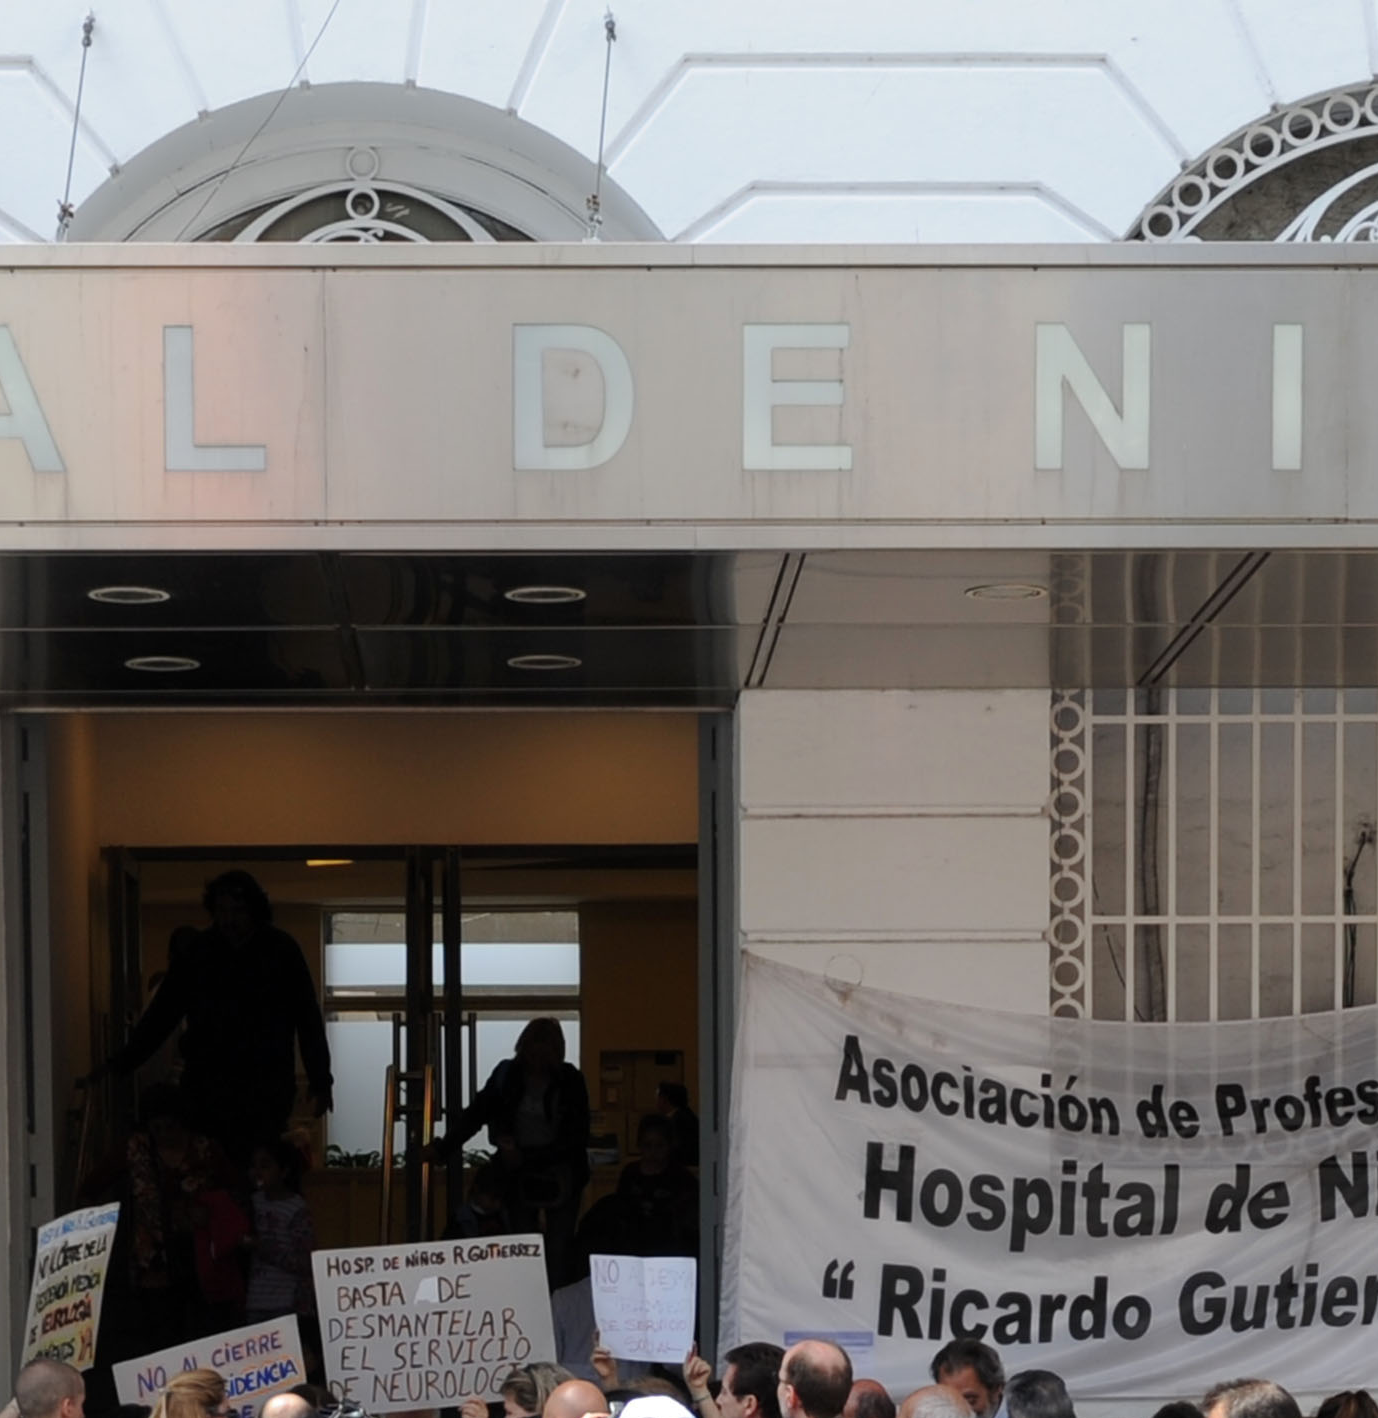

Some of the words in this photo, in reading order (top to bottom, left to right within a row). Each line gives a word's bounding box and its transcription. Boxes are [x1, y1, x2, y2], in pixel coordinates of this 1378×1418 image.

[511, 321, 854, 473] DE
[833, 1034, 1121, 1137] Asociación
[1136, 1083, 1201, 1139] de
[861, 1140, 1179, 1254] Hospital
[1204, 1153, 1292, 1236] de
[327, 1256, 375, 1278] HOSP.
[383, 1256, 400, 1271] DE
[337, 1281, 406, 1312] BASTA
[437, 1274, 472, 1303] DE
[876, 1262, 1152, 1344] Ricardo
[328, 1307, 523, 1343] DESMANTELAR
[341, 1345, 376, 1371] EL
[393, 1336, 532, 1371] SERVICIO
[137, 1365, 167, 1399] NO
[224, 1358, 298, 1397] SIDENCIA
[371, 1363, 523, 1403] NEUROLOG
